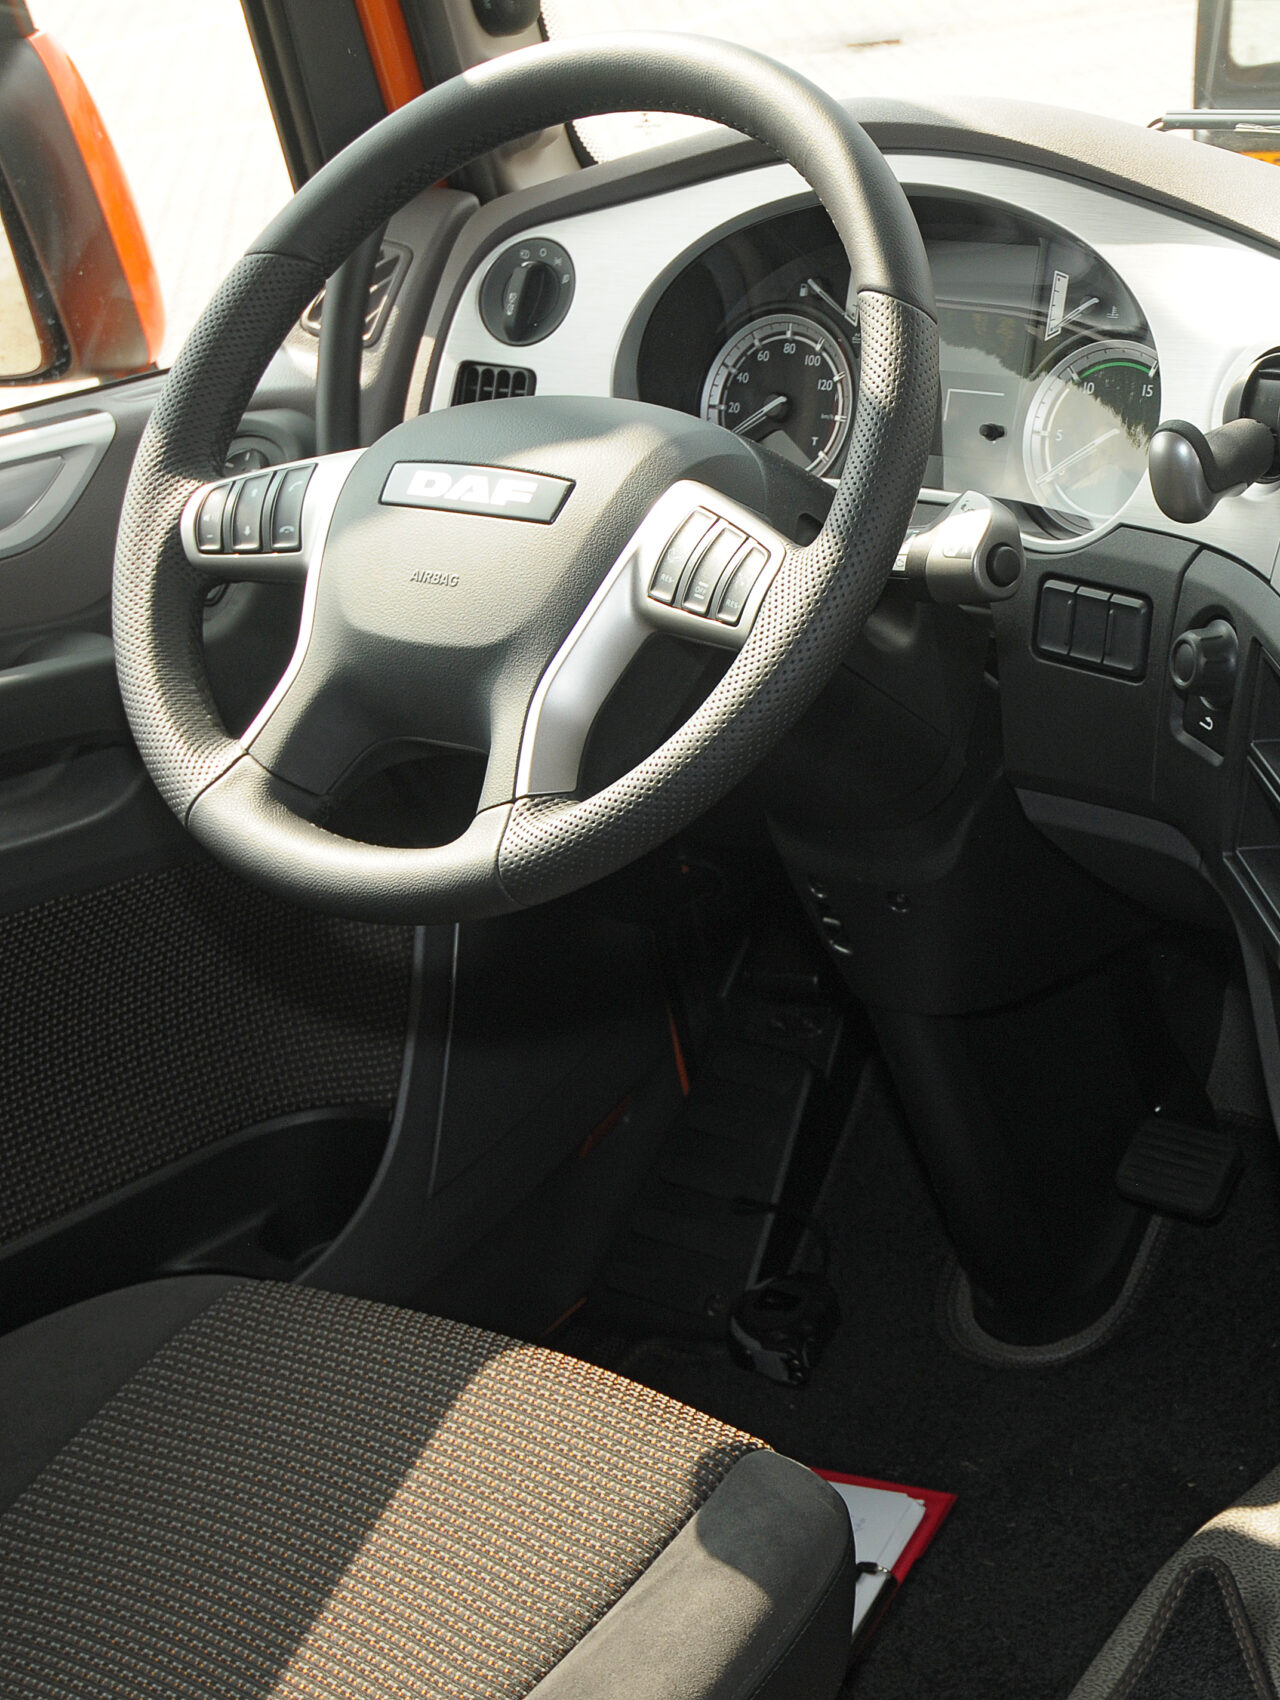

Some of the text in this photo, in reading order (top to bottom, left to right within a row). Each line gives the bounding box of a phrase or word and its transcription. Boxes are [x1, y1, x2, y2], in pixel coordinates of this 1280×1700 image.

[783, 343, 796, 354] 80
[757, 351, 770, 362] 60
[804, 355, 821, 367] 100
[736, 373, 749, 384] 40
[817, 380, 833, 391] 120
[1083, 382, 1095, 395] 10
[1141, 384, 1154, 397] 15
[728, 402, 741, 413] 20
[1055, 430, 1063, 441] 5
[406, 470, 538, 506] DAF
[409, 569, 460, 587] AIRBAG
